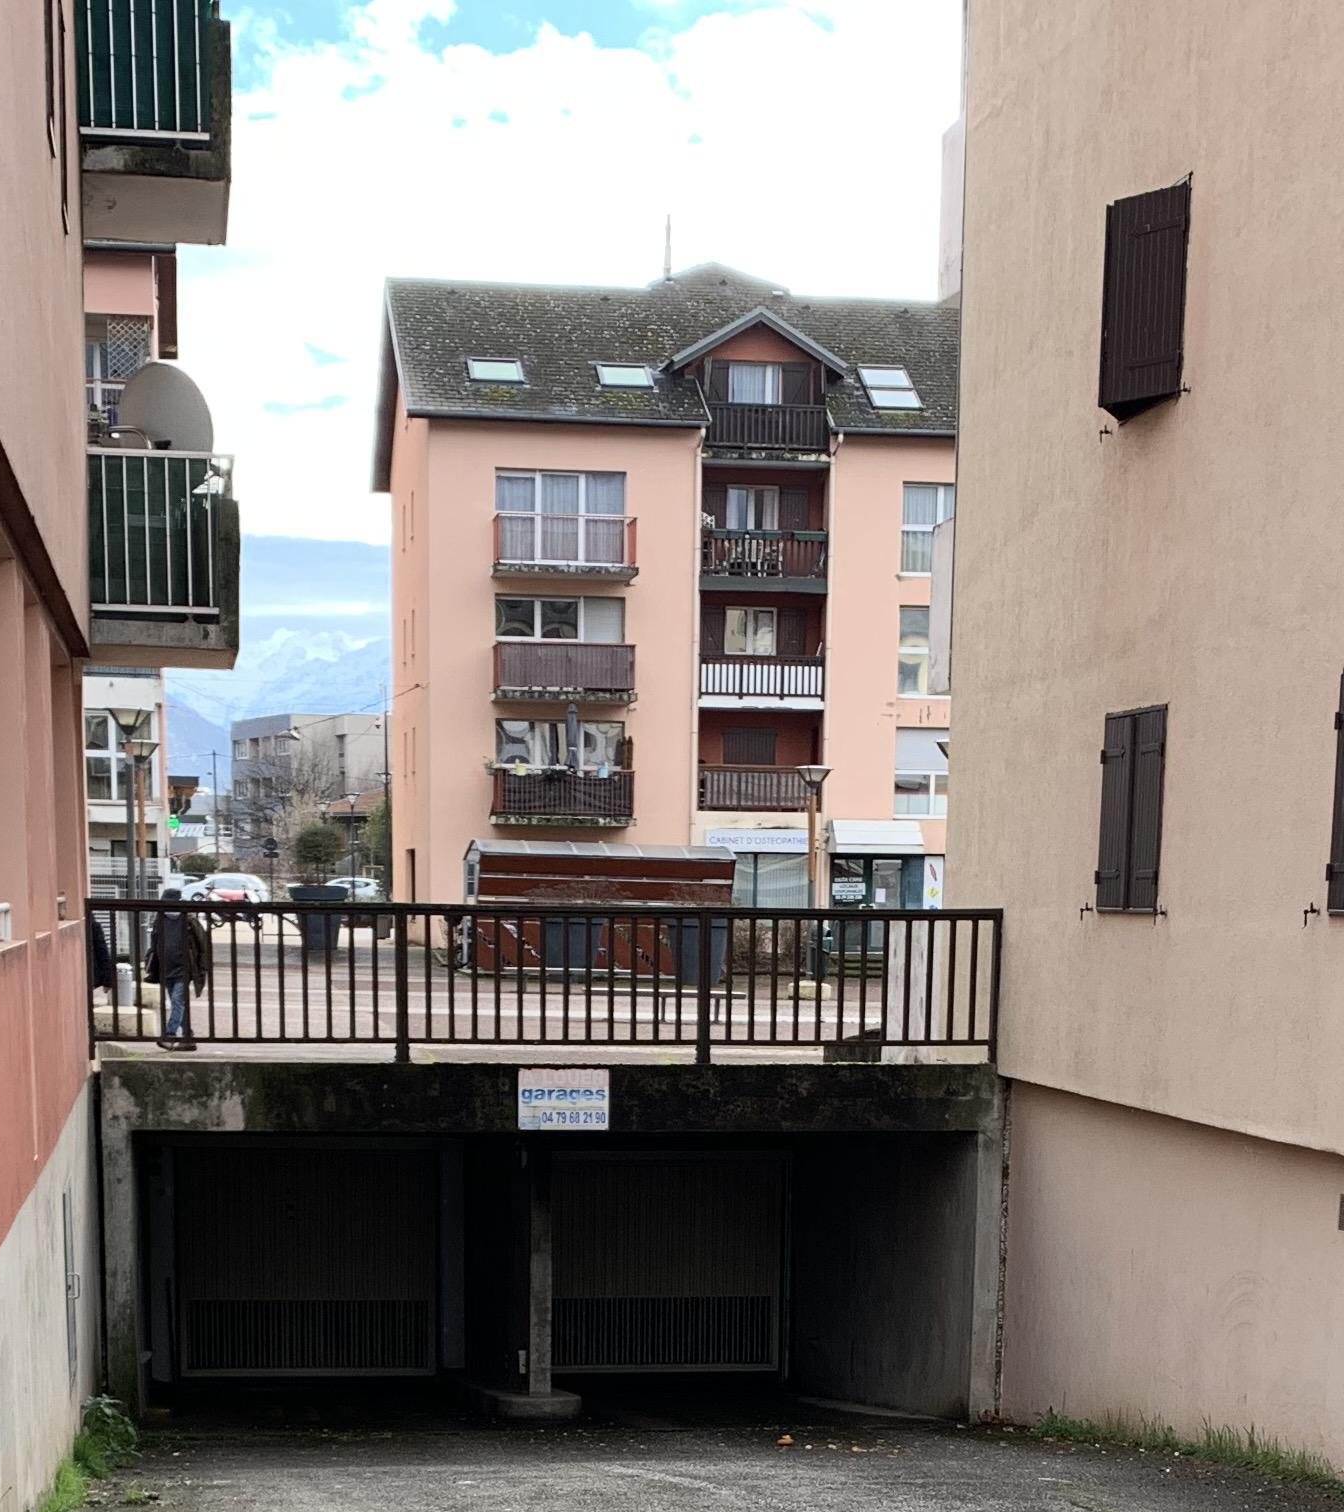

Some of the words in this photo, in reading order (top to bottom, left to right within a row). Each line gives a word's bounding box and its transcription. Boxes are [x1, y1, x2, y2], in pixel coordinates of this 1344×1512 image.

[709, 836, 744, 845] CABINET
[521, 1088, 606, 1105] garages
[541, 1112, 554, 1124] 04
[556, 1112, 567, 1124] 79
[595, 1112, 606, 1124] 90
